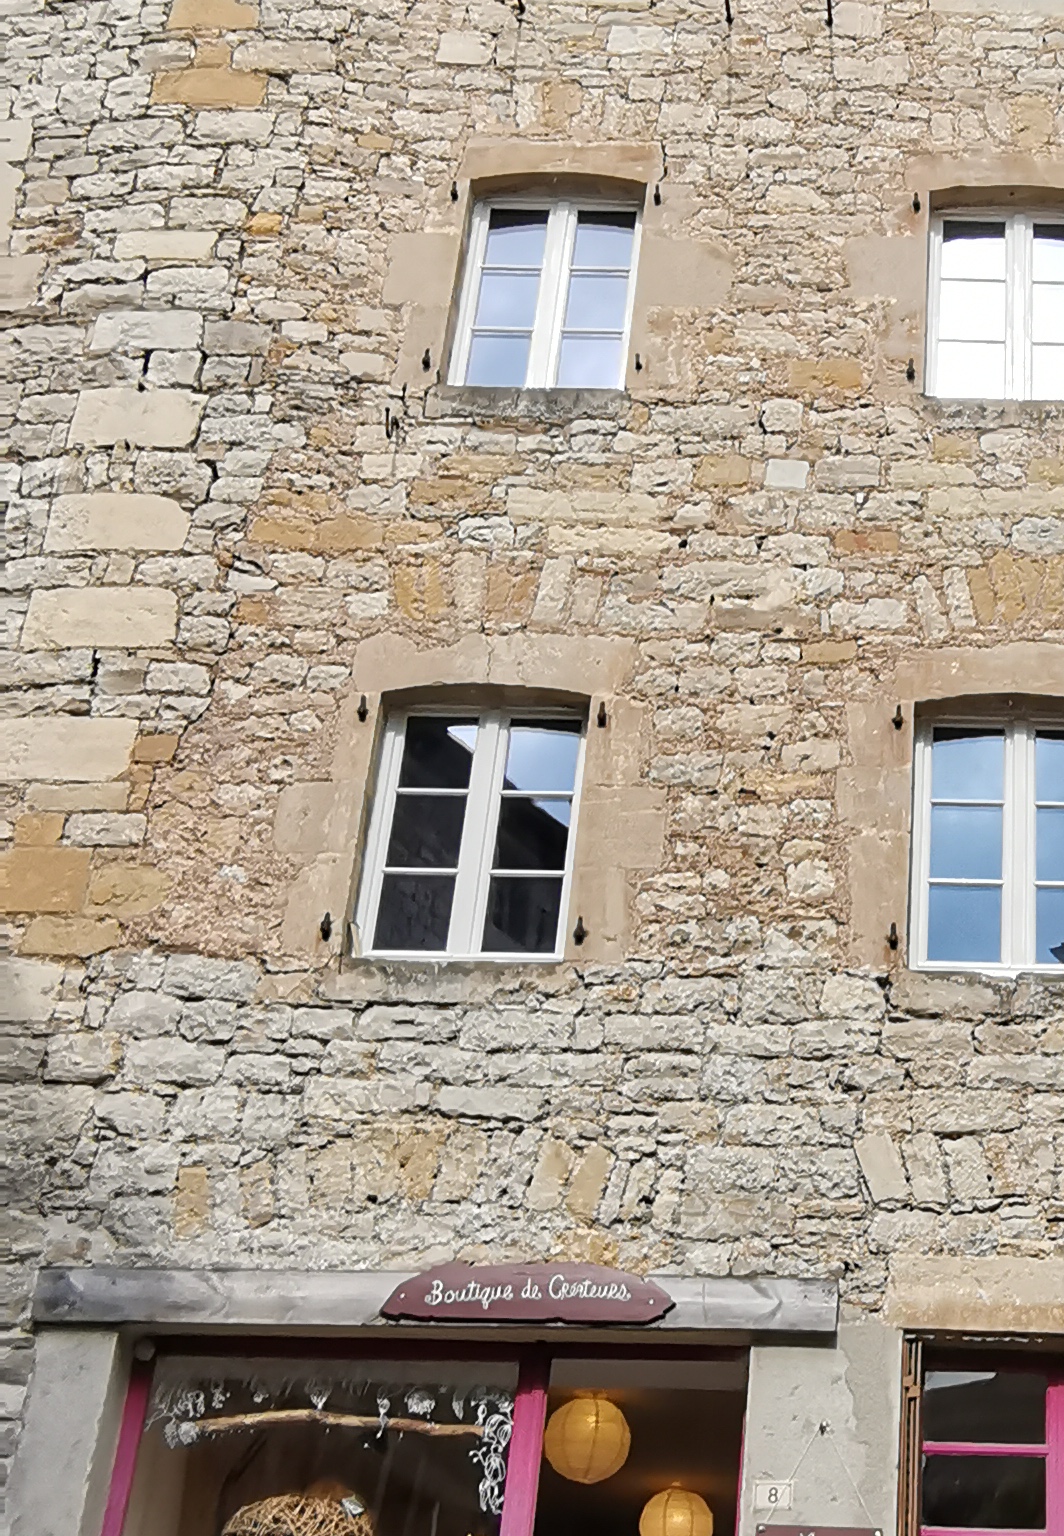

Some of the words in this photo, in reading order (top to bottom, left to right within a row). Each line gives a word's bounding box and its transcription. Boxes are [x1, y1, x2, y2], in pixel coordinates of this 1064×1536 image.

[424, 1279, 514, 1310] Boutique
[520, 1277, 542, 1300] de
[767, 1487, 779, 1504] 8
